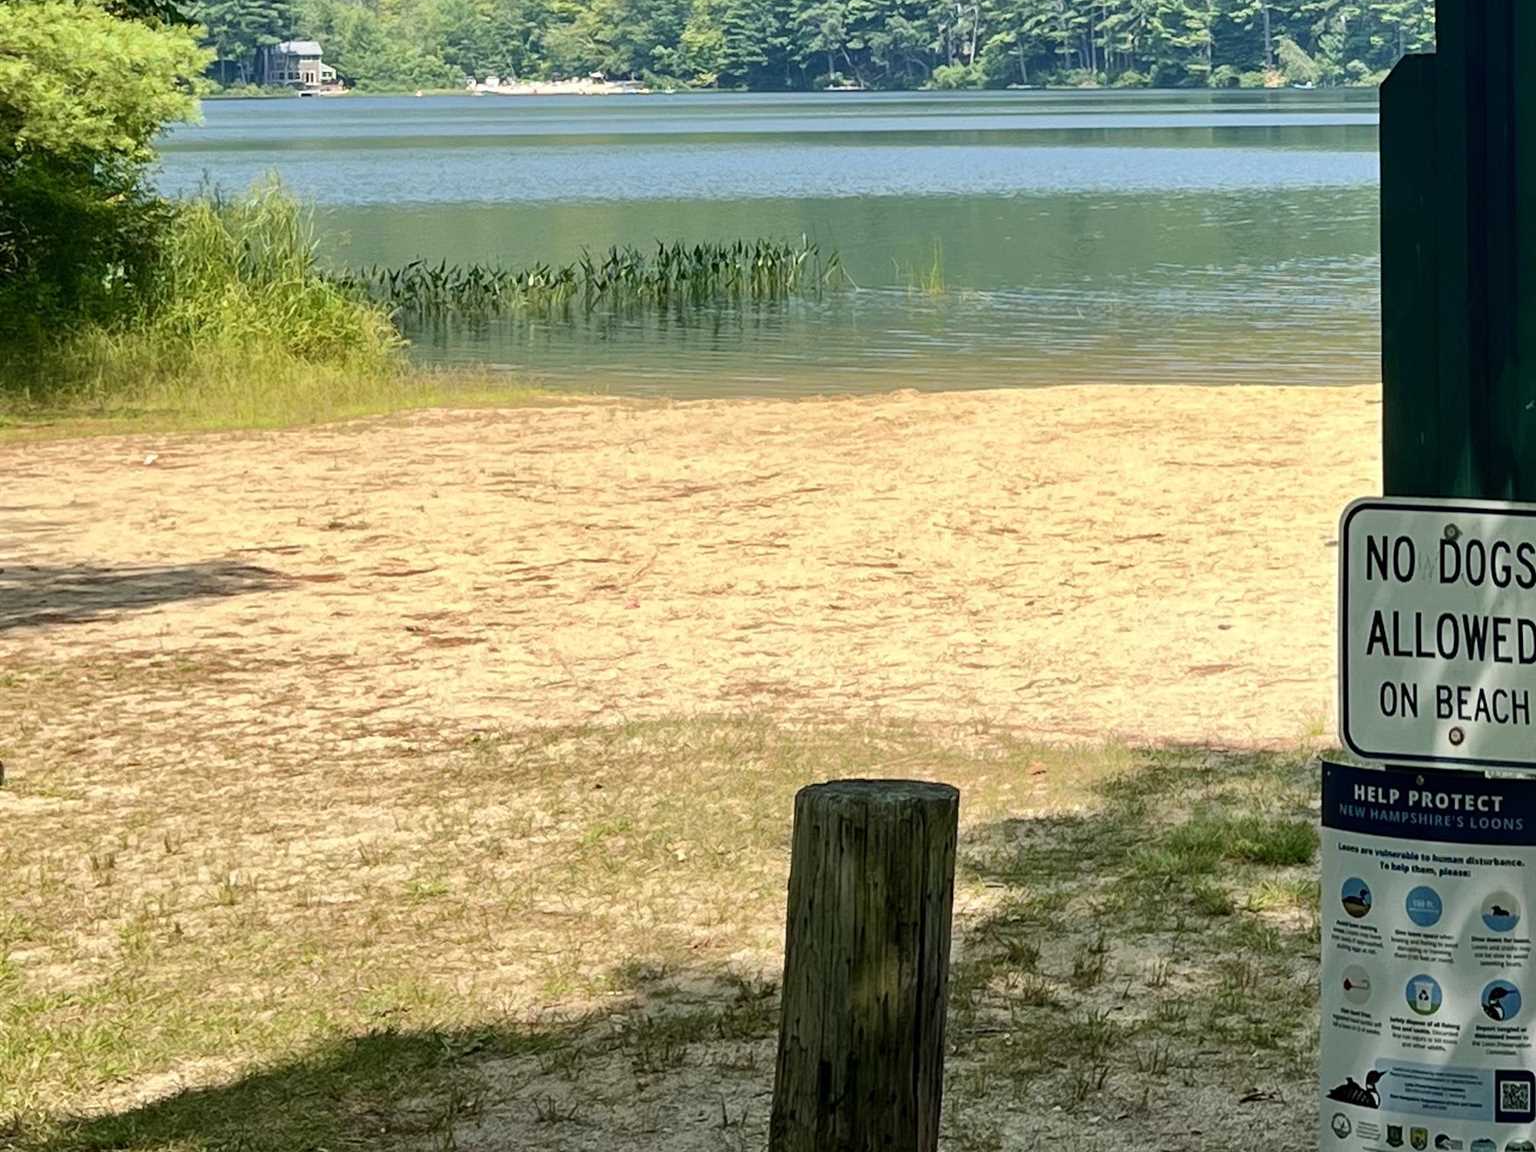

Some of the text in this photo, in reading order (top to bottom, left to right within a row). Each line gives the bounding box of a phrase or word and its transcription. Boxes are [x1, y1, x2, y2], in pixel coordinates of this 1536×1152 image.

[1365, 534, 1416, 583] NO
[1379, 681, 1531, 725] ON BEACH
[1353, 783, 1504, 813] HELP PROTECT
[1338, 803, 1525, 831] NEW HAMPSHIRE'S LOONS
[1391, 862, 1410, 875] help
[1411, 864, 1438, 877] them,
[1421, 852, 1431, 863] to
[1432, 853, 1465, 865] human
[1466, 855, 1526, 868] disturbance.
